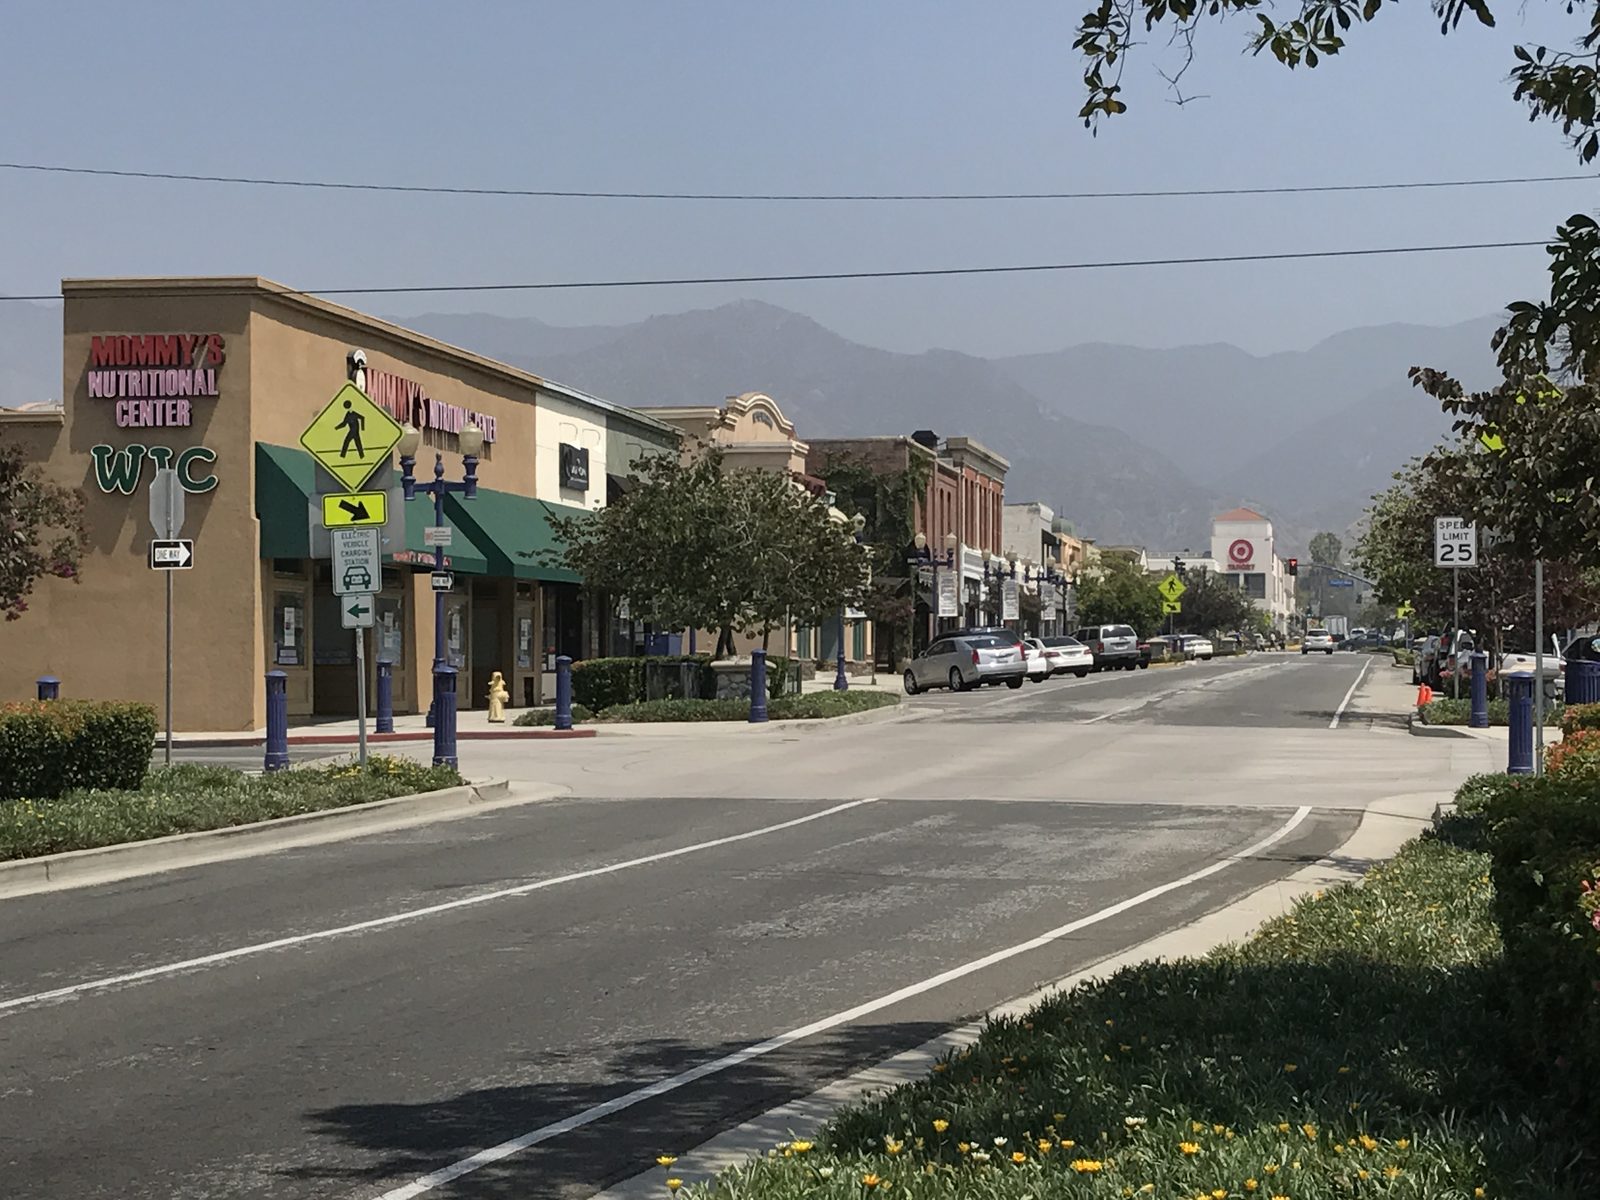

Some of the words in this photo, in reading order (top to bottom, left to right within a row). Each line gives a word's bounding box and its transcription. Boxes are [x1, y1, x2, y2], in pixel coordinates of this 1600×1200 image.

[91, 334, 224, 366] MOMMY'S
[88, 369, 219, 397] NUTRITIONAL
[116, 399, 191, 427] CENTER
[341, 531, 370, 540] ELECTRIC
[1442, 532, 1469, 541] LIMIT
[343, 540, 369, 548] VEHICLE
[156, 549, 168, 560] ONE
[168, 549, 180, 560] WAY
[341, 548, 372, 558] CHARGING
[1440, 544, 1472, 561] 25
[344, 558, 370, 567] STATION
